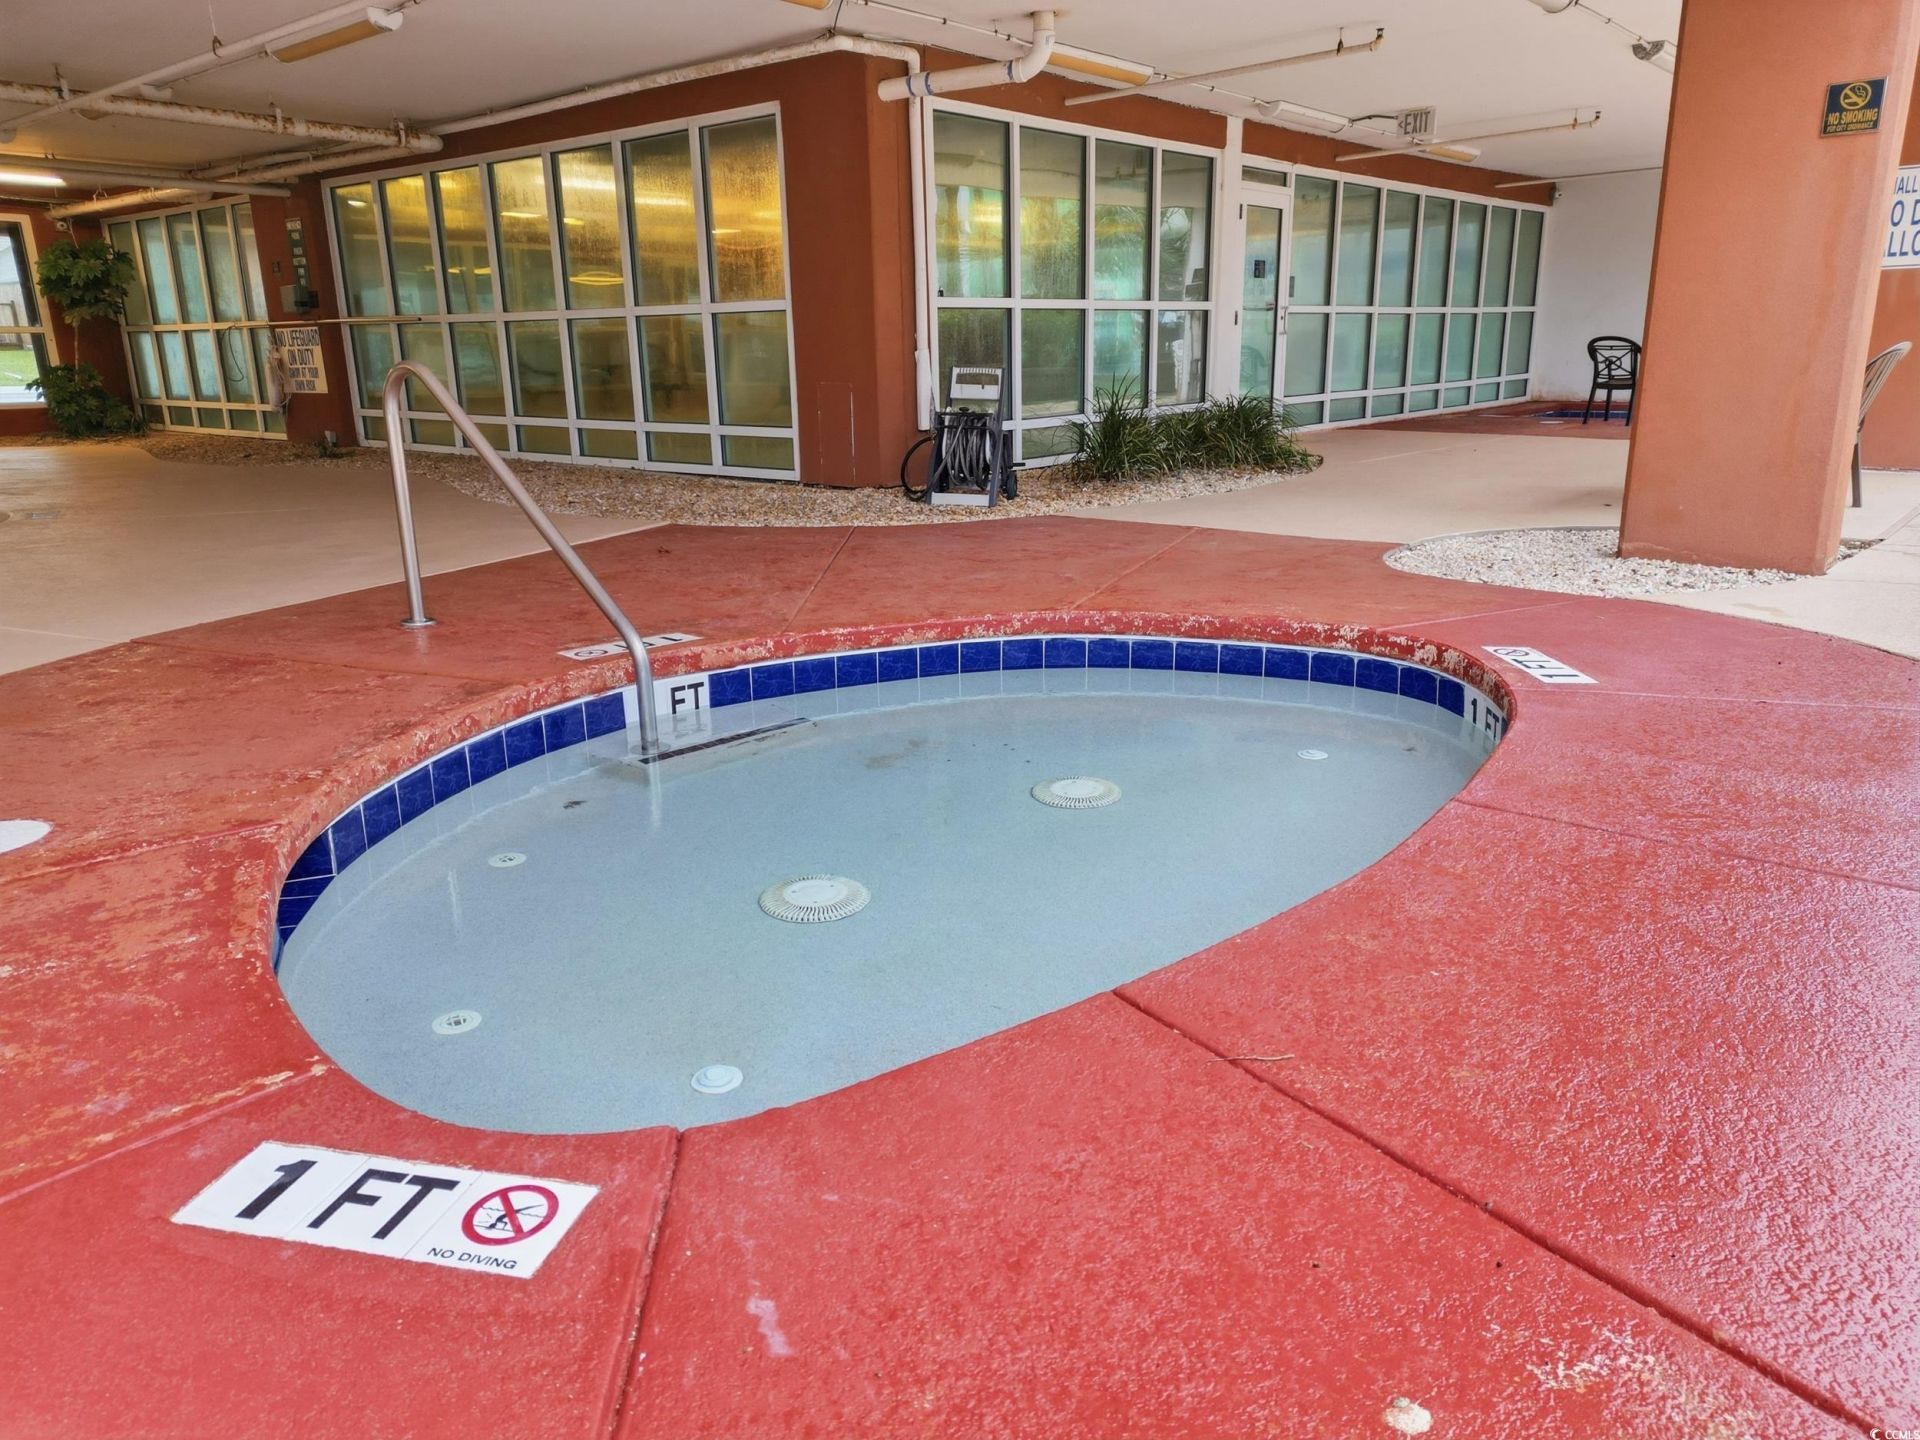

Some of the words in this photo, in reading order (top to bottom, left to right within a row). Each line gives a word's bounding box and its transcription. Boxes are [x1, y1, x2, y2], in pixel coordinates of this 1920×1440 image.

[1404, 111, 1430, 135] EXIT
[1828, 112, 1840, 125] NO
[1841, 108, 1878, 124] SMOKING
[1884, 230, 1920, 257] LLO
[275, 330, 287, 348] NO
[287, 328, 320, 347] LIFEGUARD
[287, 349, 297, 366] ON
[297, 348, 315, 366] DUTY
[670, 681, 705, 715] FT
[1471, 698, 1478, 725] 1
[1484, 706, 1500, 742] FT
[234, 1158, 318, 1221] 1
[307, 1168, 461, 1240] FT
[427, 1247, 456, 1262] NO
[457, 1251, 518, 1271] DIVING
